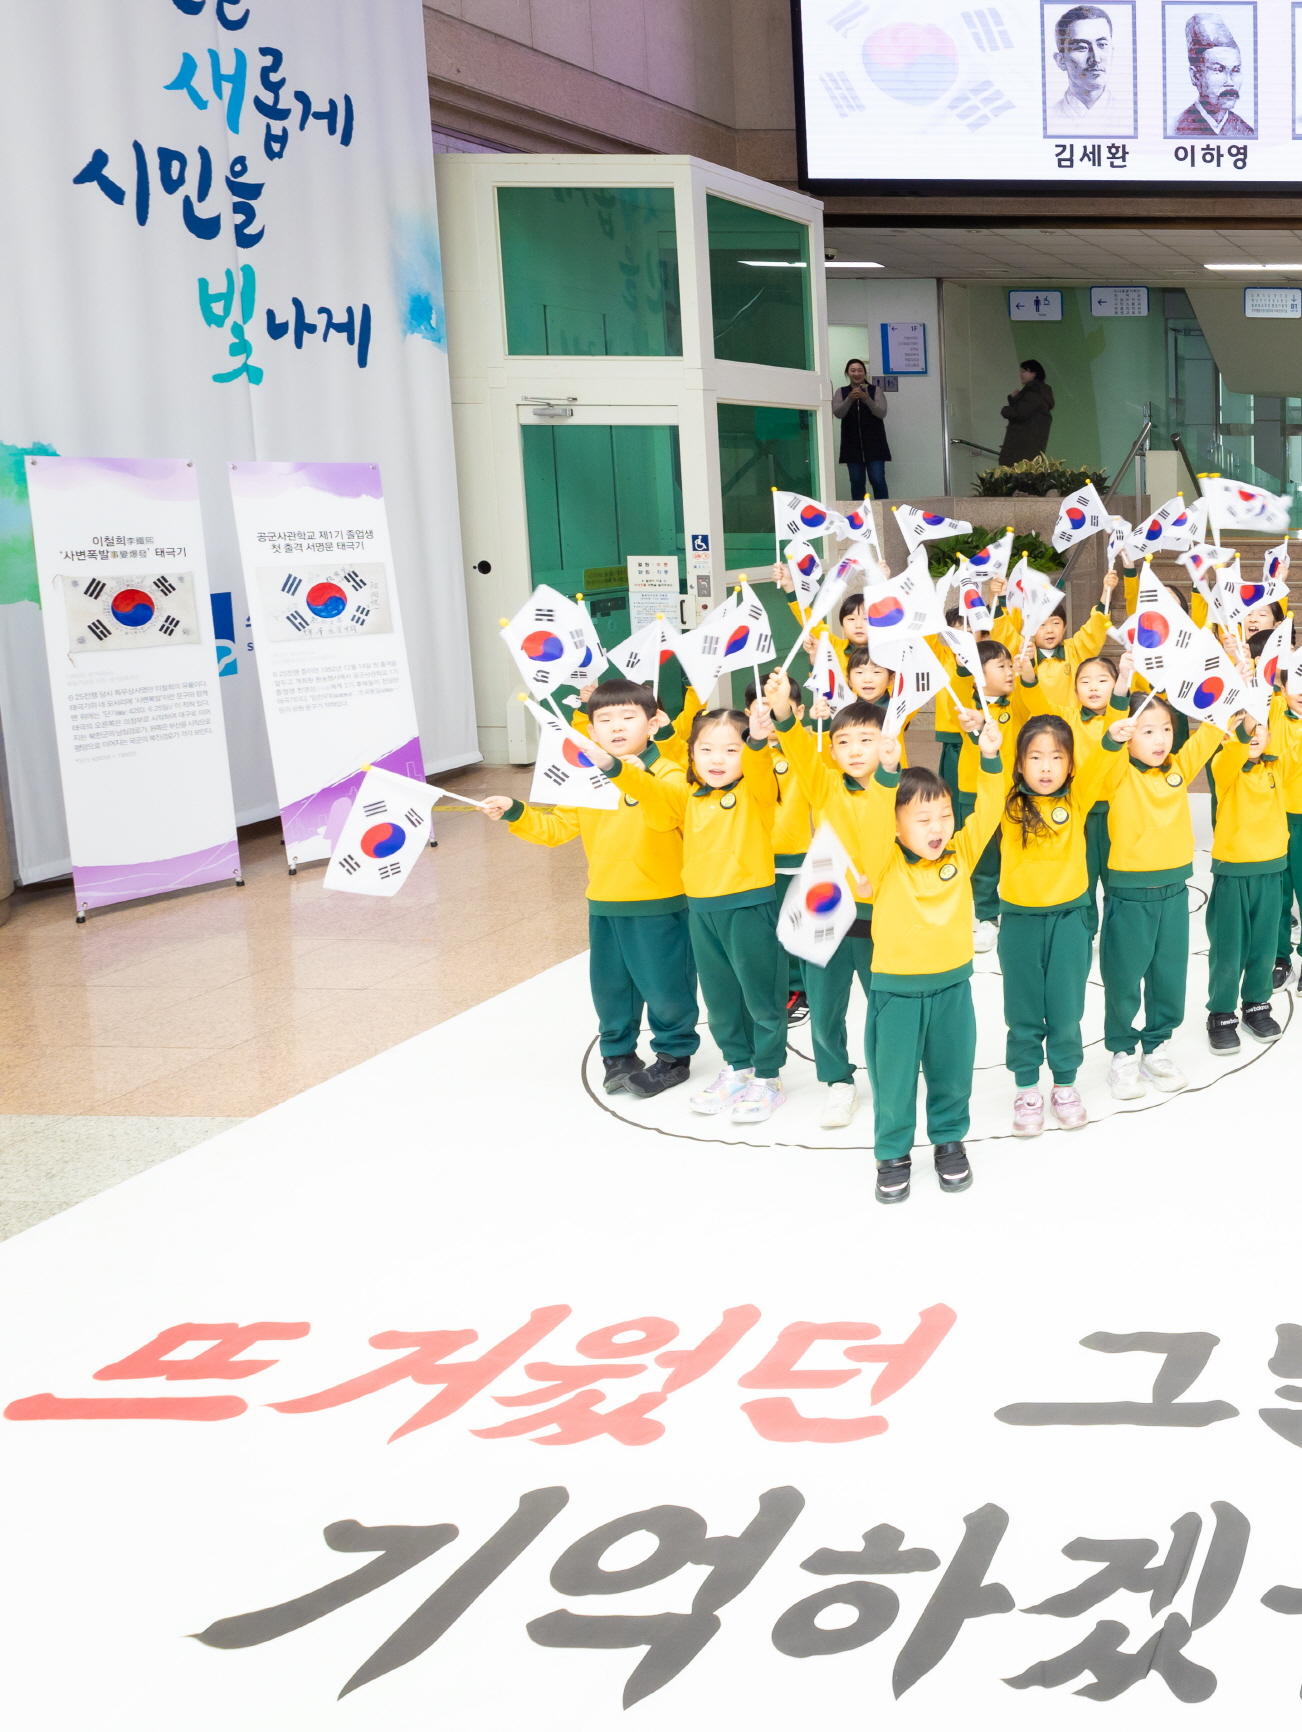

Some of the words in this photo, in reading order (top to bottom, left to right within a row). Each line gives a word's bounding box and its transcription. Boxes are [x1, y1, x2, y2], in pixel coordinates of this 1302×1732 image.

[160, 47, 354, 165] 새롭게
[1055, 143, 1129, 168] 김세환
[1175, 144, 1247, 169] 이하영
[73, 135, 270, 249] 시민을
[198, 264, 371, 385] 빛나게
[257, 531, 316, 542] 공군사관학교
[319, 530, 343, 540] 제1기
[346, 529, 374, 539] 졸업생
[155, 547, 187, 558] 태극기
[271, 543, 281, 553] 첫
[284, 543, 303, 553] 출격
[306, 542, 334, 552] 서명문
[337, 541, 364, 550] 태극기
[70, 702, 97, 710] 태극기의
[176, 692, 194, 700] 문구와
[99, 690, 113, 698] 당시
[124, 716, 149, 725] 의정부로
[152, 713, 177, 721] 시작하여
[102, 739, 128, 748] 이어지는
[129, 736, 148, 744] 국군의
[3, 1303, 956, 1446] 뜨거웠던
